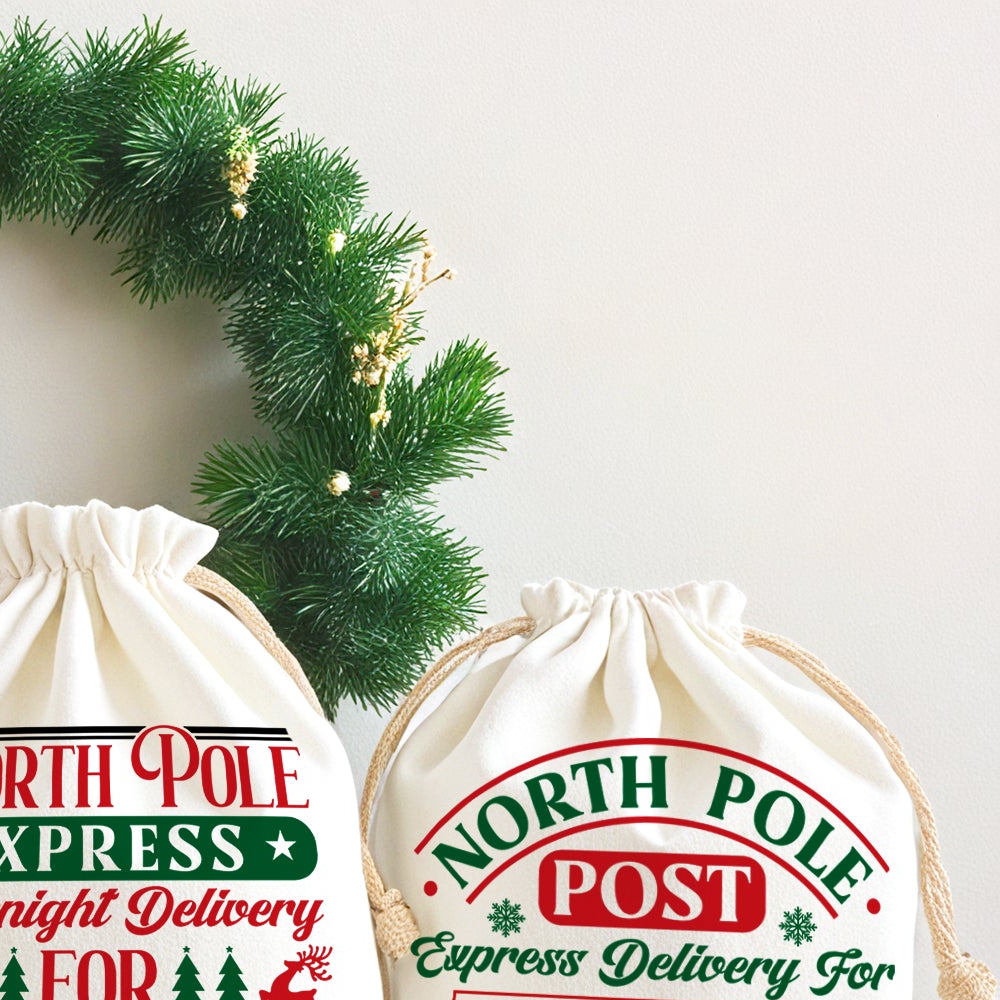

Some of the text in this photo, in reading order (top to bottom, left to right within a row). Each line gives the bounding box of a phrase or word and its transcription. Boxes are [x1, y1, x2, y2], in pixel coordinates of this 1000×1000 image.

[131, 725, 309, 808] POLE
[432, 756, 873, 904] NORTH POLE
[125, 886, 323, 942] Delivery
[554, 860, 750, 921] POST
[411, 931, 895, 1000] Express Delivery For
